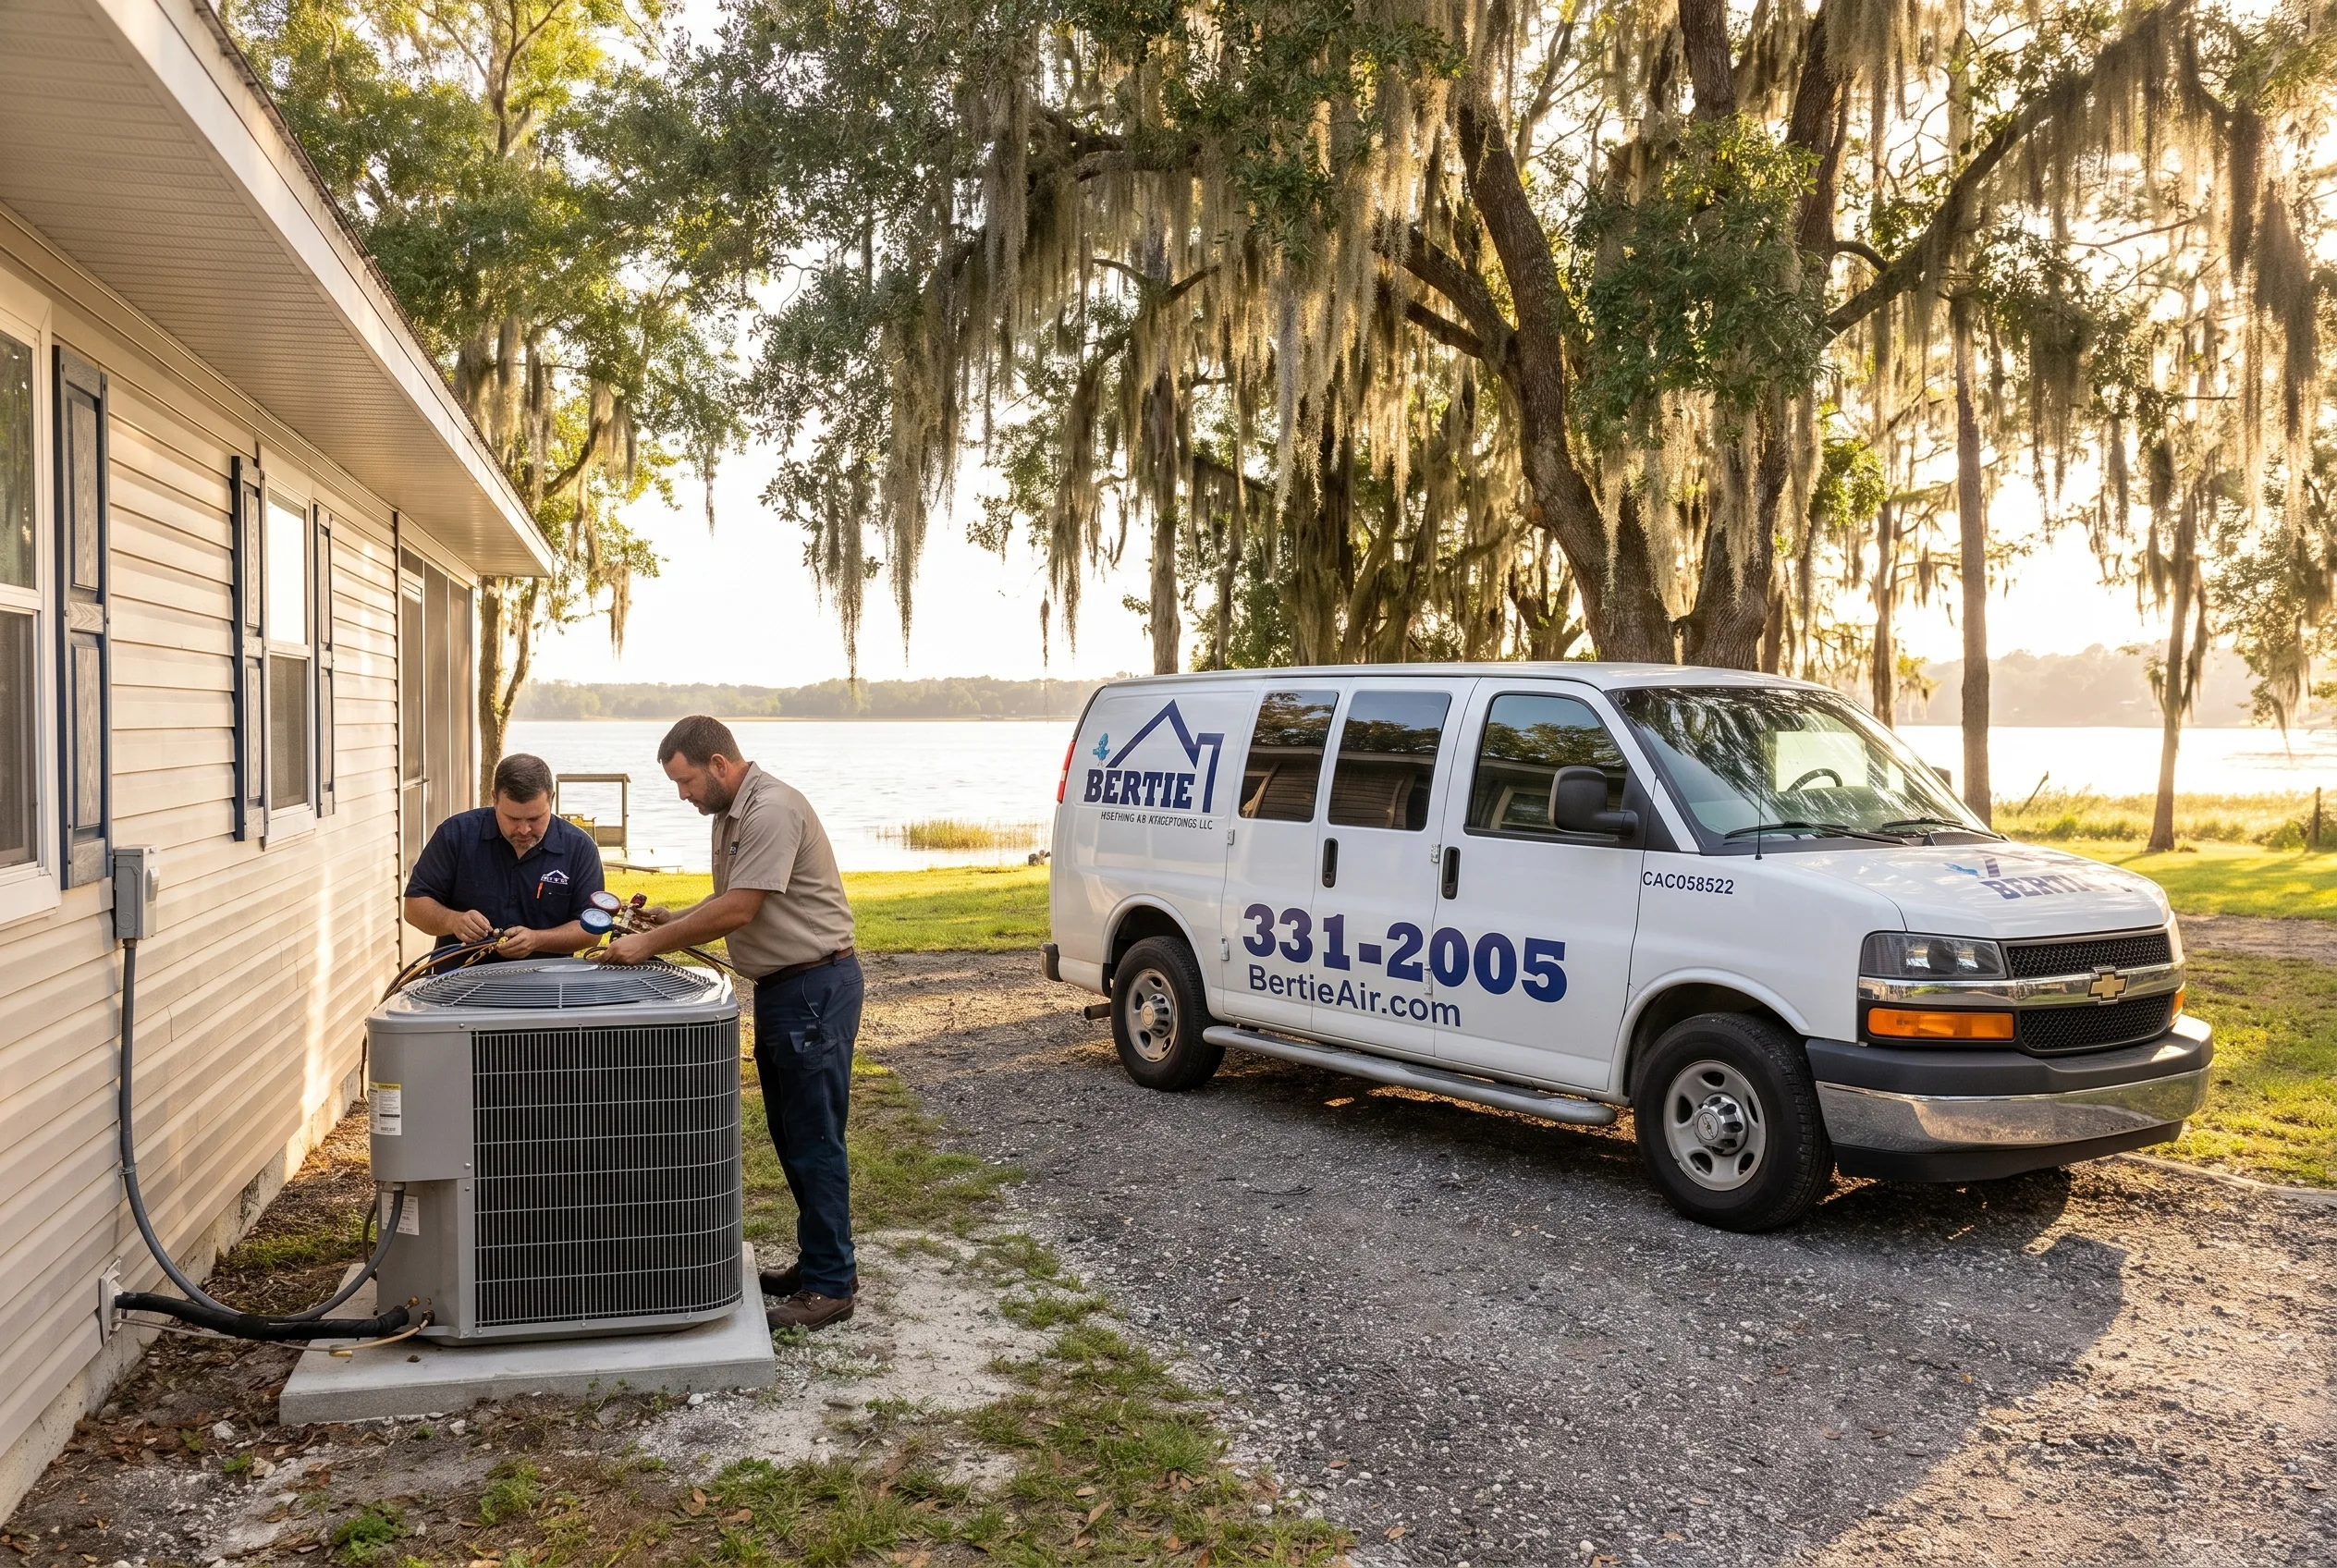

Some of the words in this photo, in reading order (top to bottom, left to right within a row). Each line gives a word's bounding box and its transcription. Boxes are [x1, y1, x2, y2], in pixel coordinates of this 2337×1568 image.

[1083, 768, 1196, 809] BERTIE
[1199, 819, 1213, 830] LLC
[1643, 871, 1734, 894] CAC058522
[1242, 902, 1568, 1003] 331-2005
[1248, 963, 1461, 1027] BertieAir.com
